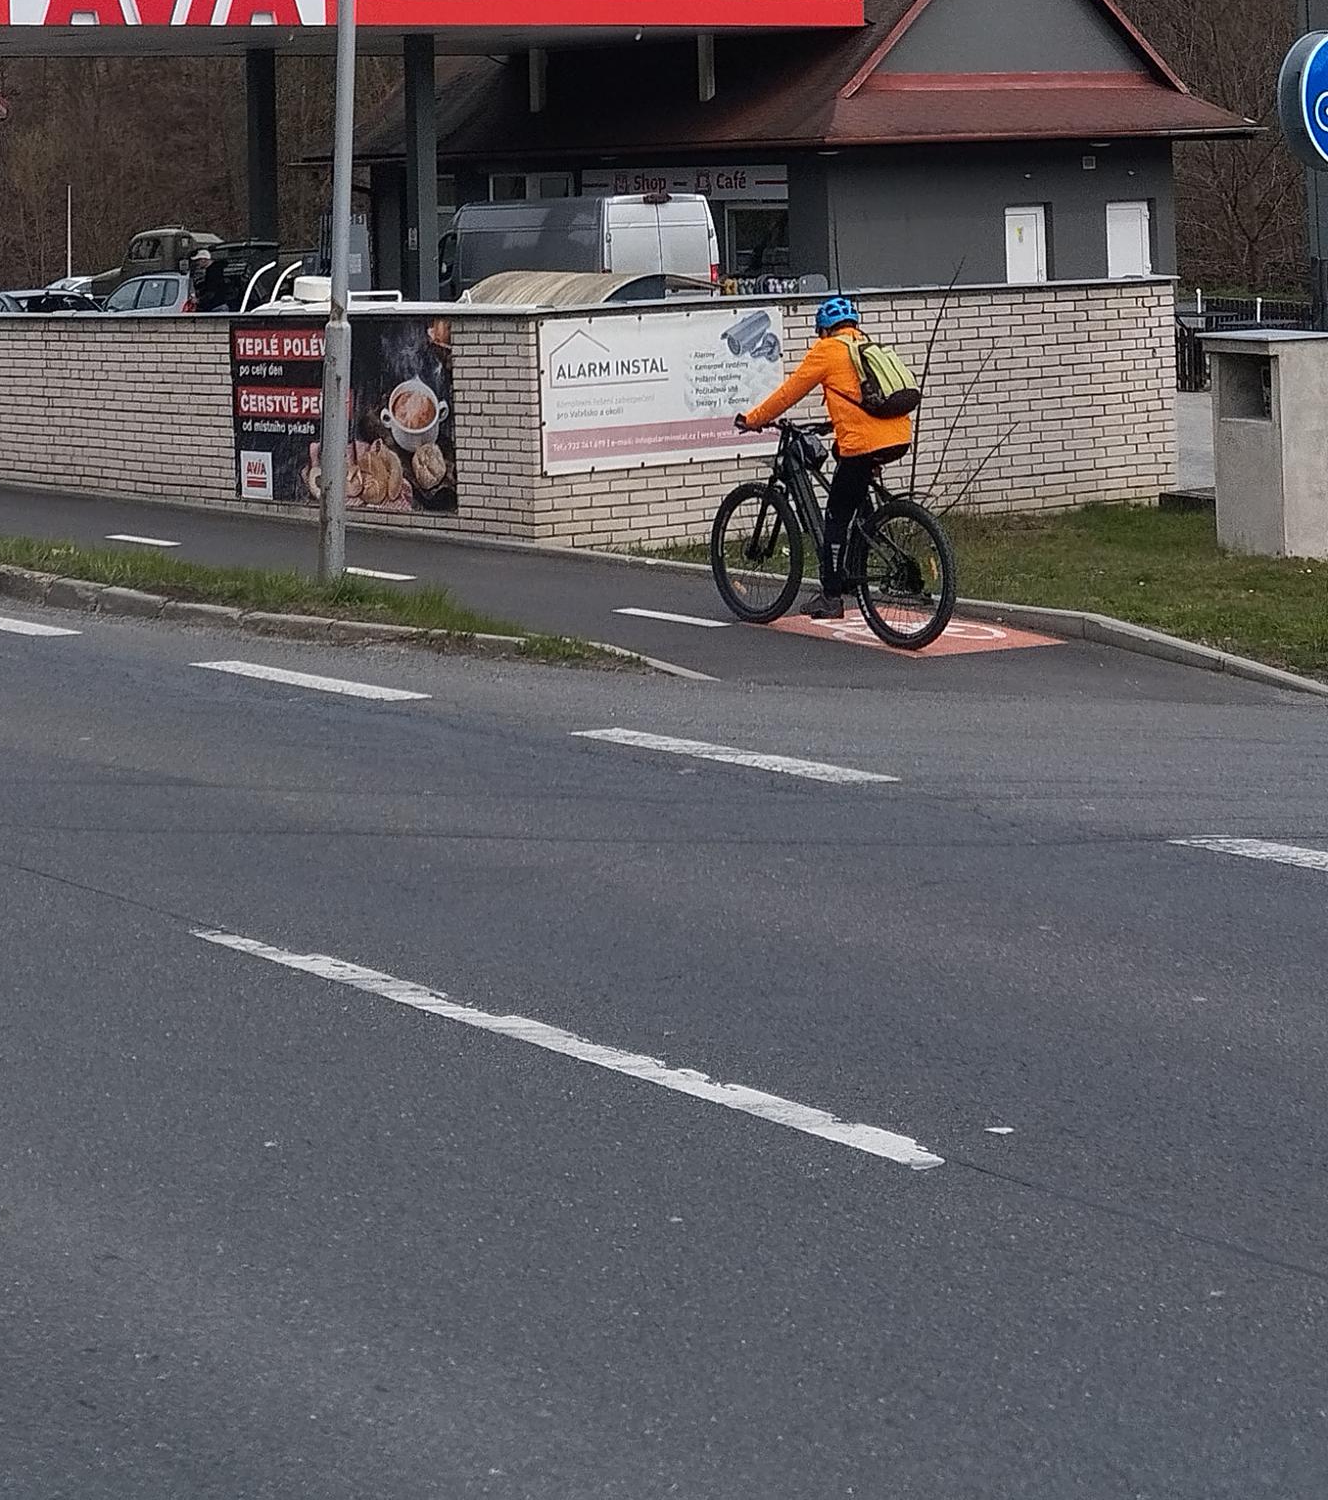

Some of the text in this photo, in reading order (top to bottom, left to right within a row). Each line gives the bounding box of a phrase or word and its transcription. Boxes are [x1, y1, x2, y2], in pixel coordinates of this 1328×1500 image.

[634, 171, 747, 194] Shop Café
[237, 334, 279, 356] TEPLÉ
[239, 363, 283, 378] po celý den
[556, 357, 669, 380] ALARM INSTAL
[240, 390, 298, 414] ČERSTVÉ
[242, 421, 252, 432] od
